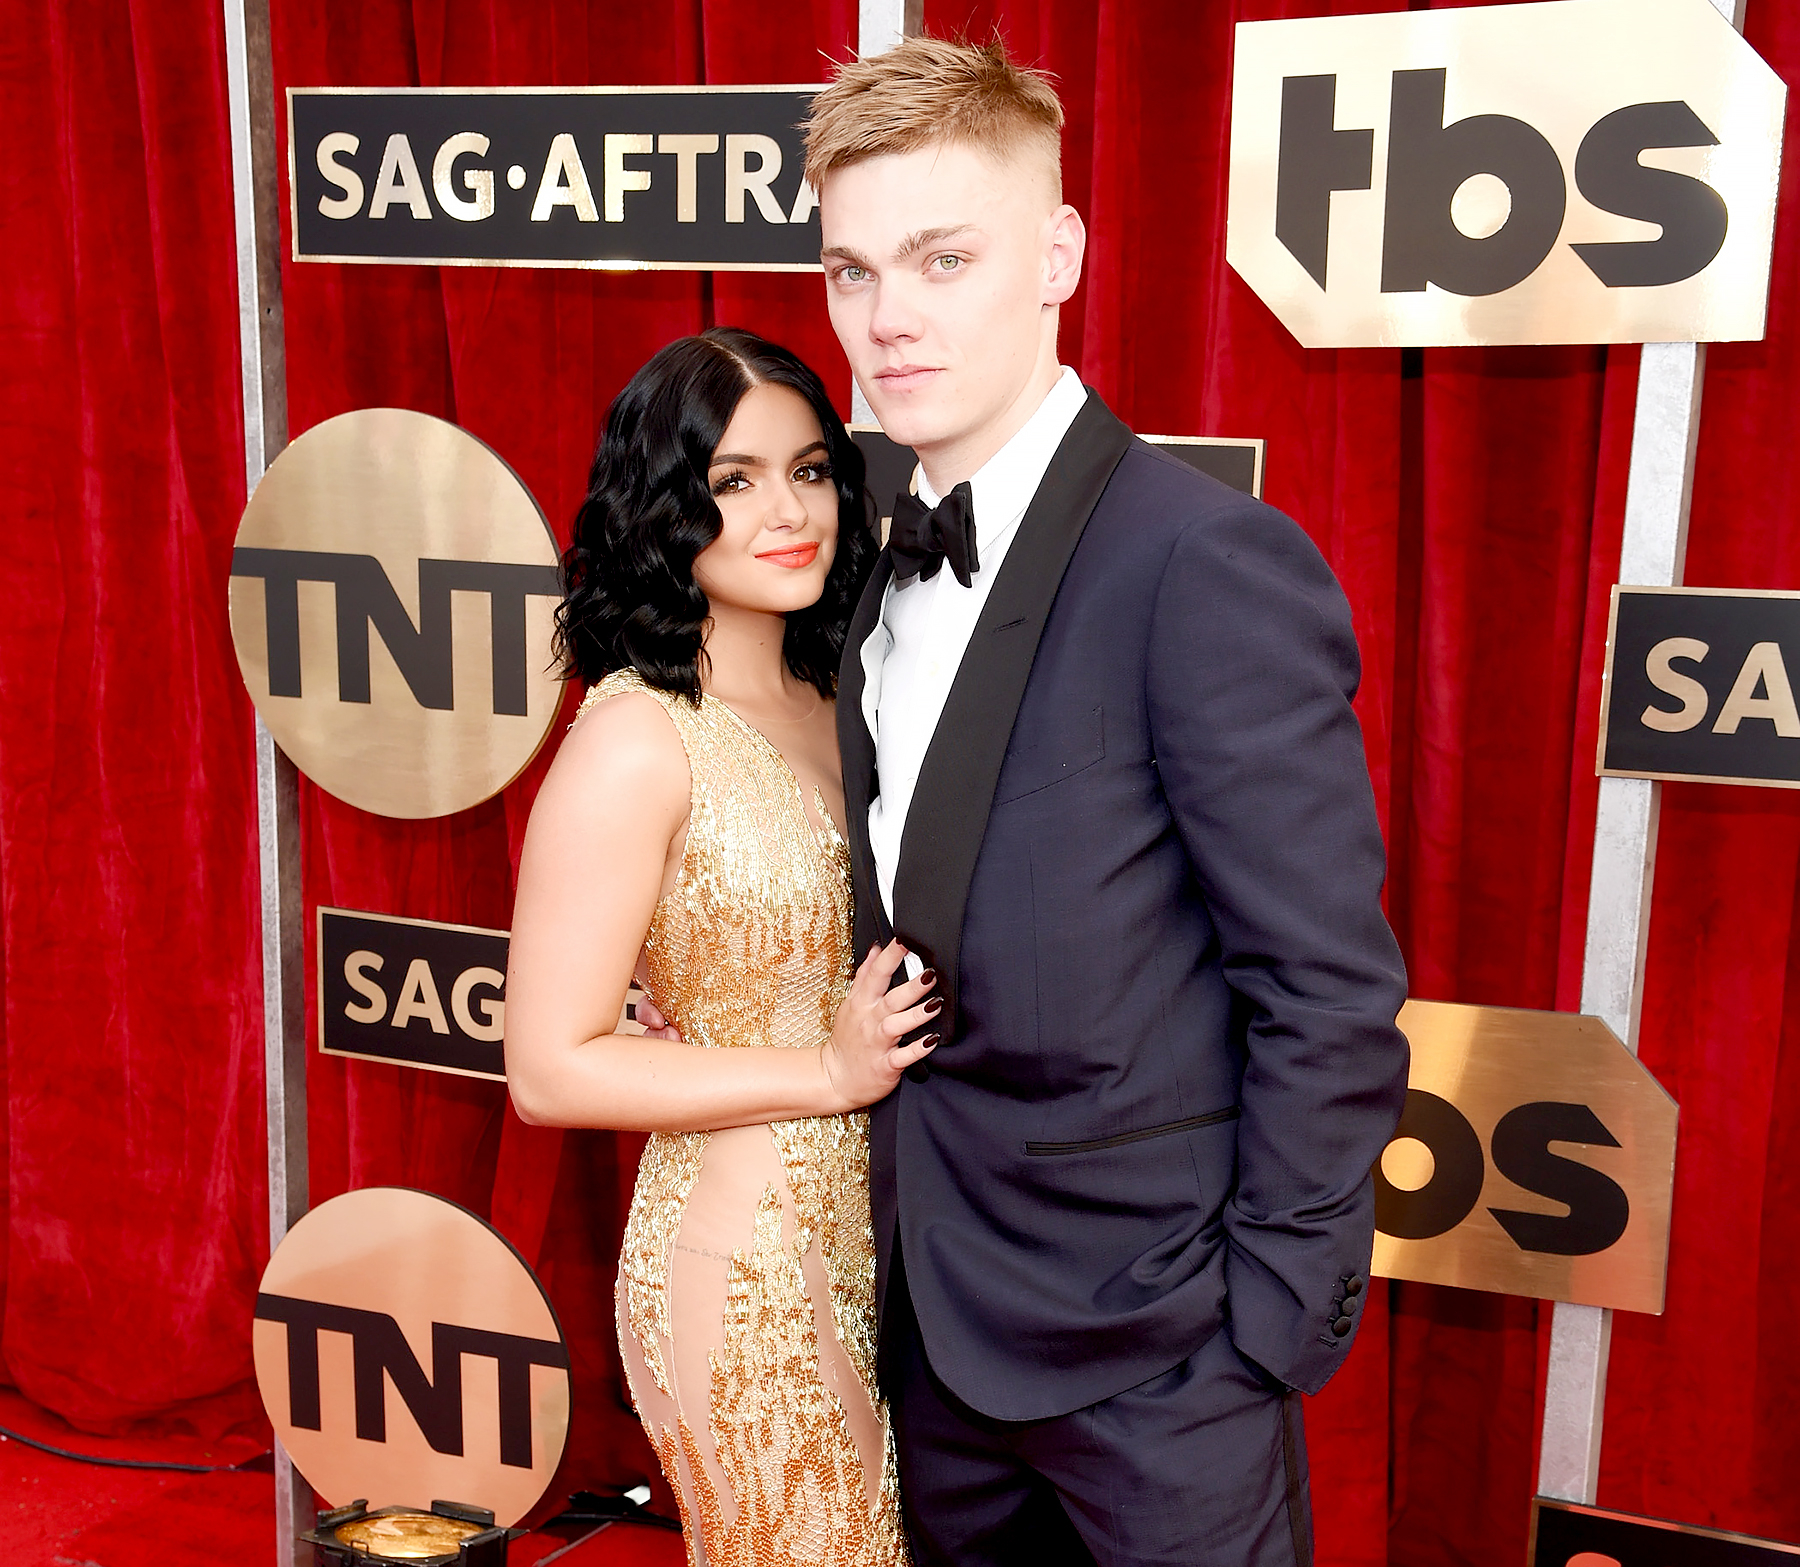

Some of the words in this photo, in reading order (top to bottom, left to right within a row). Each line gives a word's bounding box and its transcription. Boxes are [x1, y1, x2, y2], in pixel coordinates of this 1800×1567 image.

[1276, 67, 1729, 296] tbs
[231, 547, 565, 716] TNT
[254, 1292, 569, 1470] TNT
